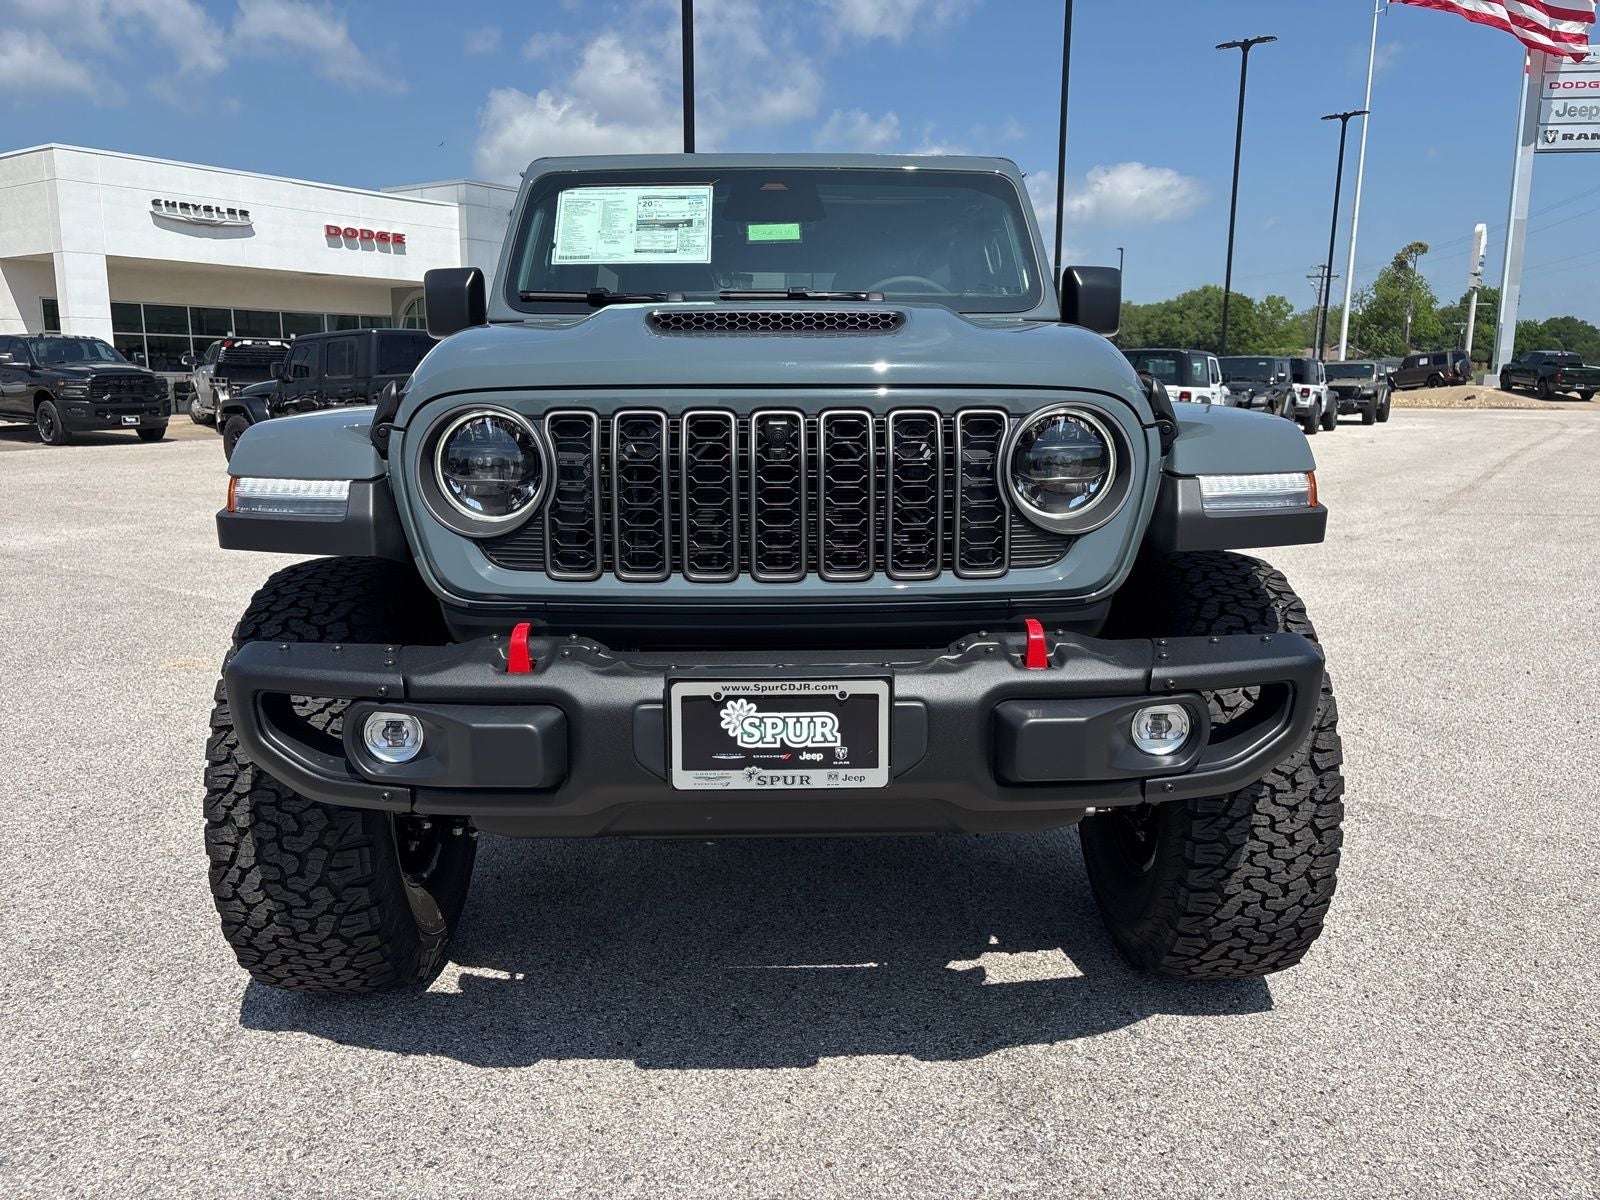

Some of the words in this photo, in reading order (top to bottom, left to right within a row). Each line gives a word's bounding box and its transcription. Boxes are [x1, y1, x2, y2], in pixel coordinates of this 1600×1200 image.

[1555, 102, 1600, 120] Jeep
[150, 198, 250, 217] CHRYSLER
[325, 224, 406, 245] DODGE
[721, 683, 839, 693] www.SpurCDJR.com
[739, 714, 840, 746] SPUR
[798, 751, 824, 762] Jeep
[757, 775, 811, 786] SPUR
[842, 773, 866, 783] Jeep
